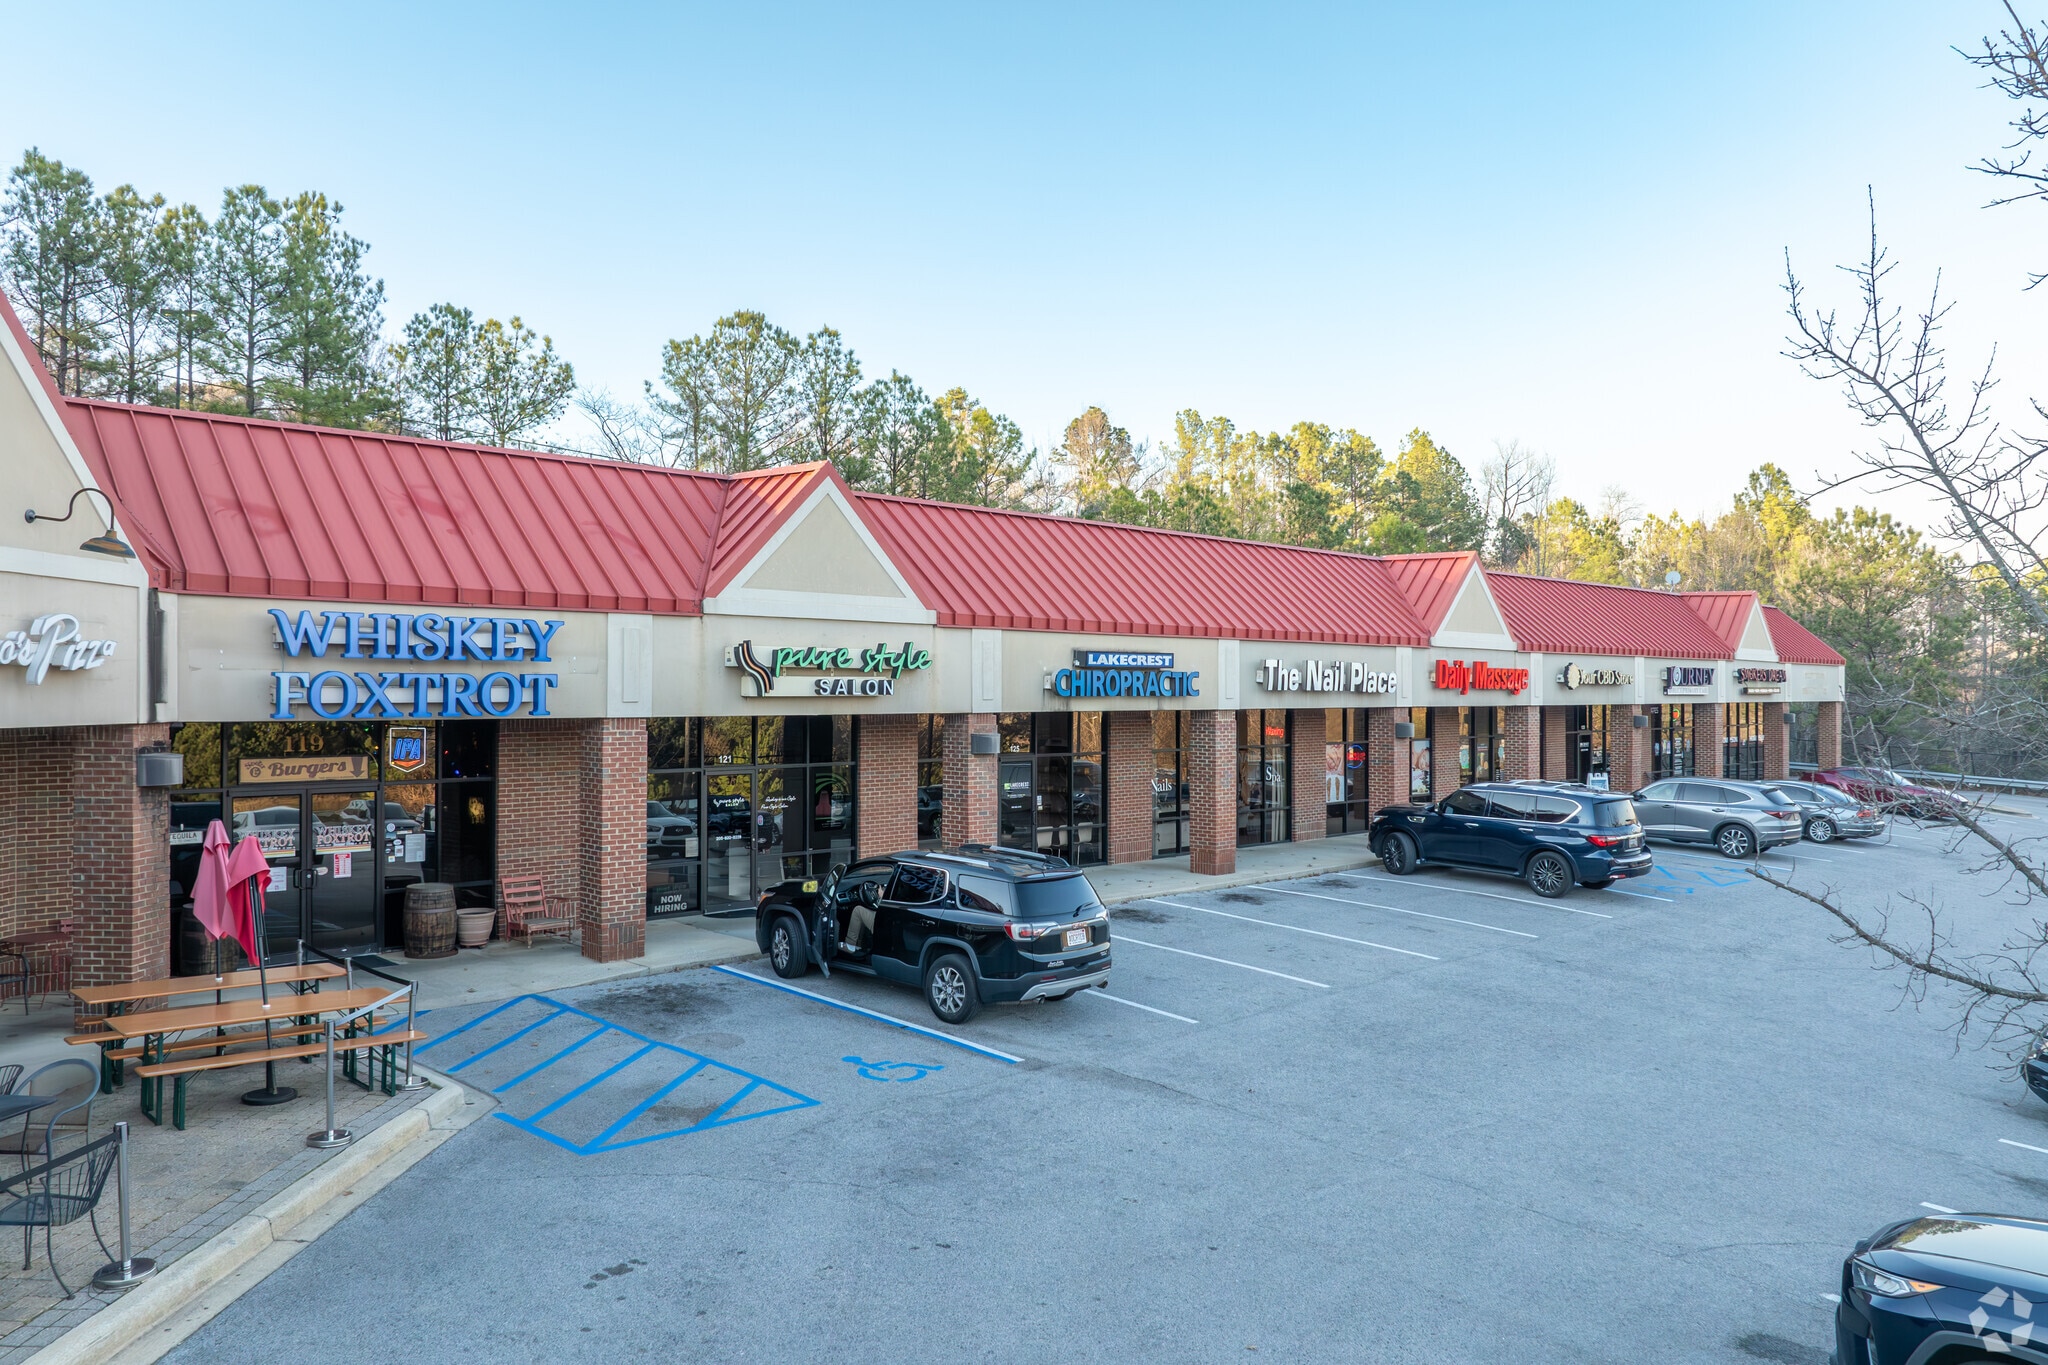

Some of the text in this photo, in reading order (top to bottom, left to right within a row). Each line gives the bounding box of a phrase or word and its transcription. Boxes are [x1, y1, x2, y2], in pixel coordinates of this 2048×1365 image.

[267, 608, 565, 662] WHISKEY
[26, 613, 118, 686] Pizza
[771, 641, 933, 680] pure style
[1088, 653, 1172, 666] LAKECREST
[1053, 668, 1200, 697] CHIROPRACTIC
[1264, 658, 1398, 694] The Nail Place
[1435, 659, 1529, 695] Daily Massage
[1597, 669, 1615, 685] CBD
[1615, 670, 1635, 686] Store
[1667, 666, 1715, 688] JOURNEY
[268, 670, 559, 719] FOXTROT
[815, 678, 895, 696] SALON
[284, 734, 324, 753] 119
[393, 738, 426, 761] IPA
[719, 755, 732, 763] 121
[268, 760, 347, 779] Burgers
[1265, 766, 1281, 787] Spa
[1151, 777, 1173, 792] Nails
[315, 824, 371, 836] WHISKEY
[316, 832, 371, 845] FOXTROT
[654, 902, 687, 913] HIRING
[660, 894, 682, 904] NOW
